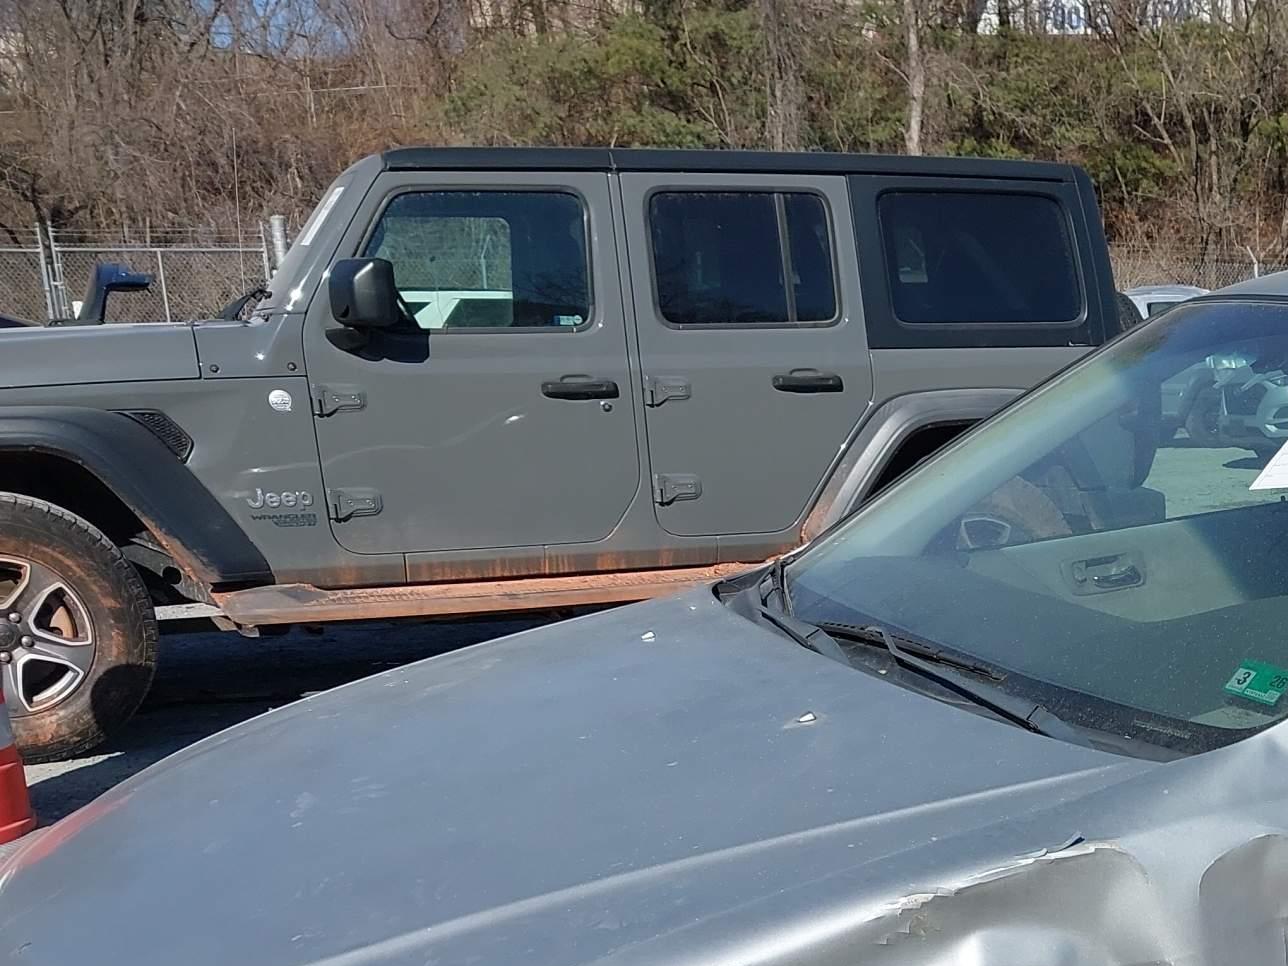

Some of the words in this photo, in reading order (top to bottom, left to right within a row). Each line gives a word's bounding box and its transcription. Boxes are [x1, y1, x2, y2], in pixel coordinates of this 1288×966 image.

[246, 487, 314, 511] Jeep
[1236, 671, 1251, 685] 3
[1270, 675, 1288, 689] 26
